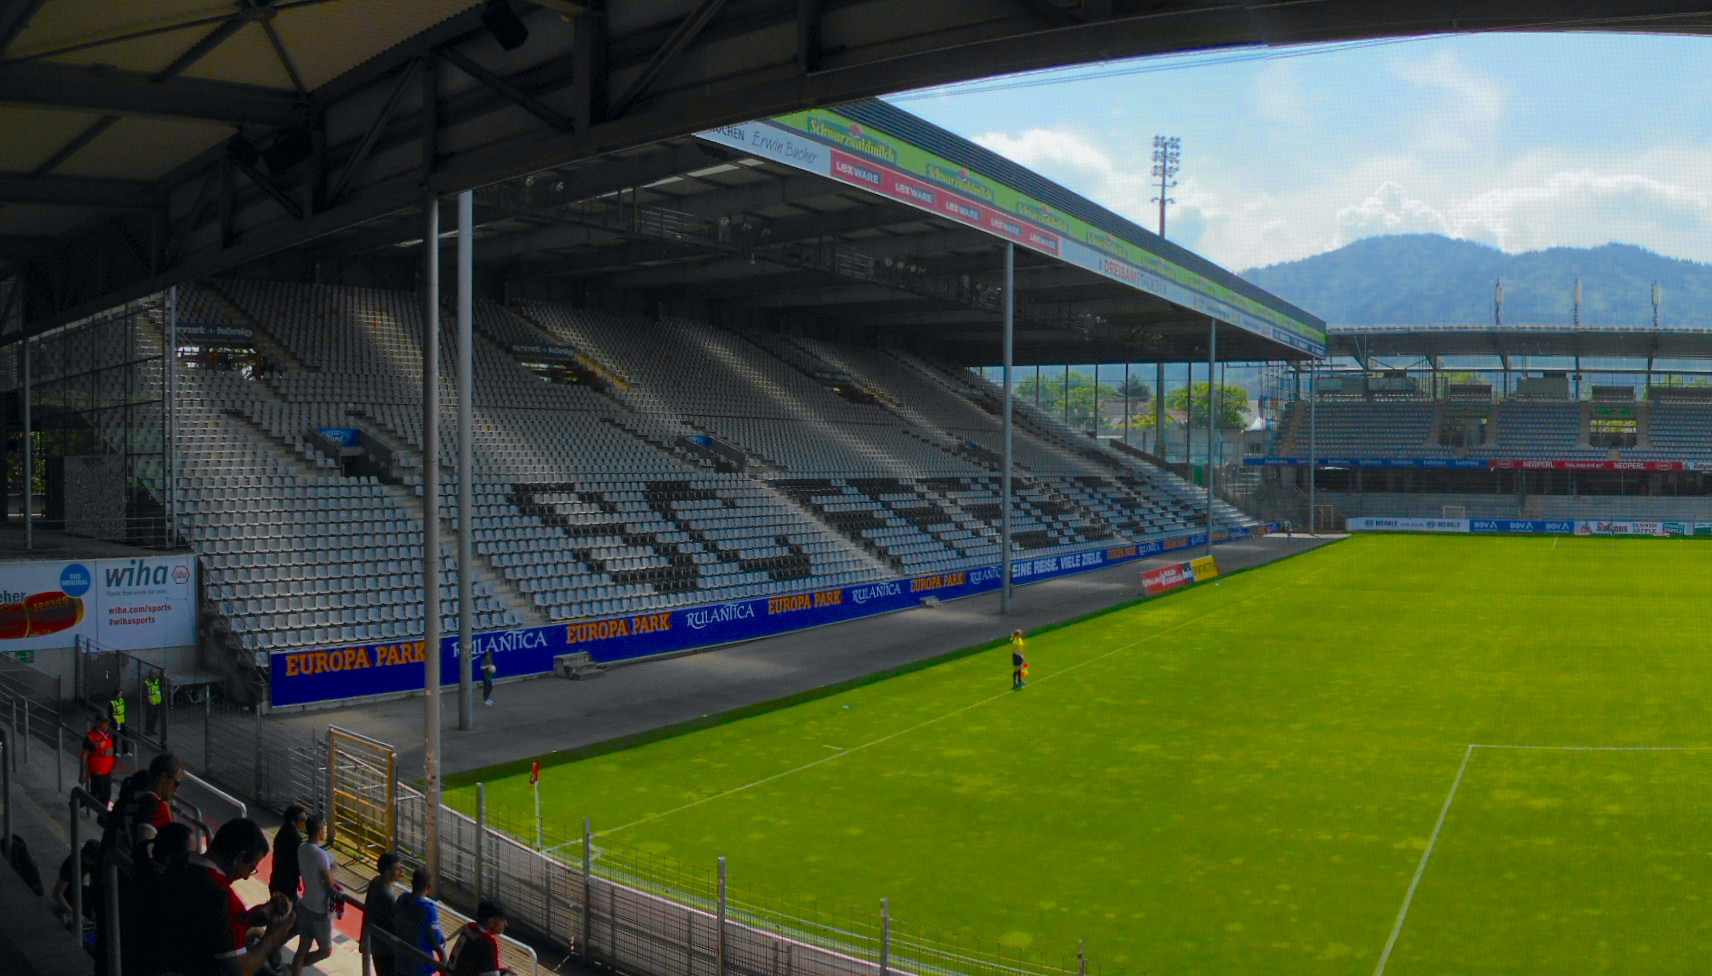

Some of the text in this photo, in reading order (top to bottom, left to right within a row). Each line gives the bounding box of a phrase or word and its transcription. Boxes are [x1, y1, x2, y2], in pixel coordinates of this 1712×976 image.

[751, 131, 784, 154] Erwin
[809, 119, 895, 163] Schwarzwaldmilch
[1613, 462, 1645, 470] NEOPERL
[105, 559, 169, 588] wiha
[1033, 557, 1059, 575] REISE.
[1060, 554, 1081, 570] VIELE
[1081, 551, 1103, 566] ZIELE.
[909, 571, 967, 592] EUROPA PARK
[970, 566, 1001, 585] RULANTIC
[768, 588, 843, 615] EUROPA PARK
[852, 580, 901, 604] RULANTICA
[108, 603, 172, 616] wiha.com/sports
[108, 615, 156, 627] #wihasports
[687, 603, 755, 629] RULANTICA
[566, 611, 672, 645] EUROPA PARK
[285, 639, 429, 676] EUROPA PARK
